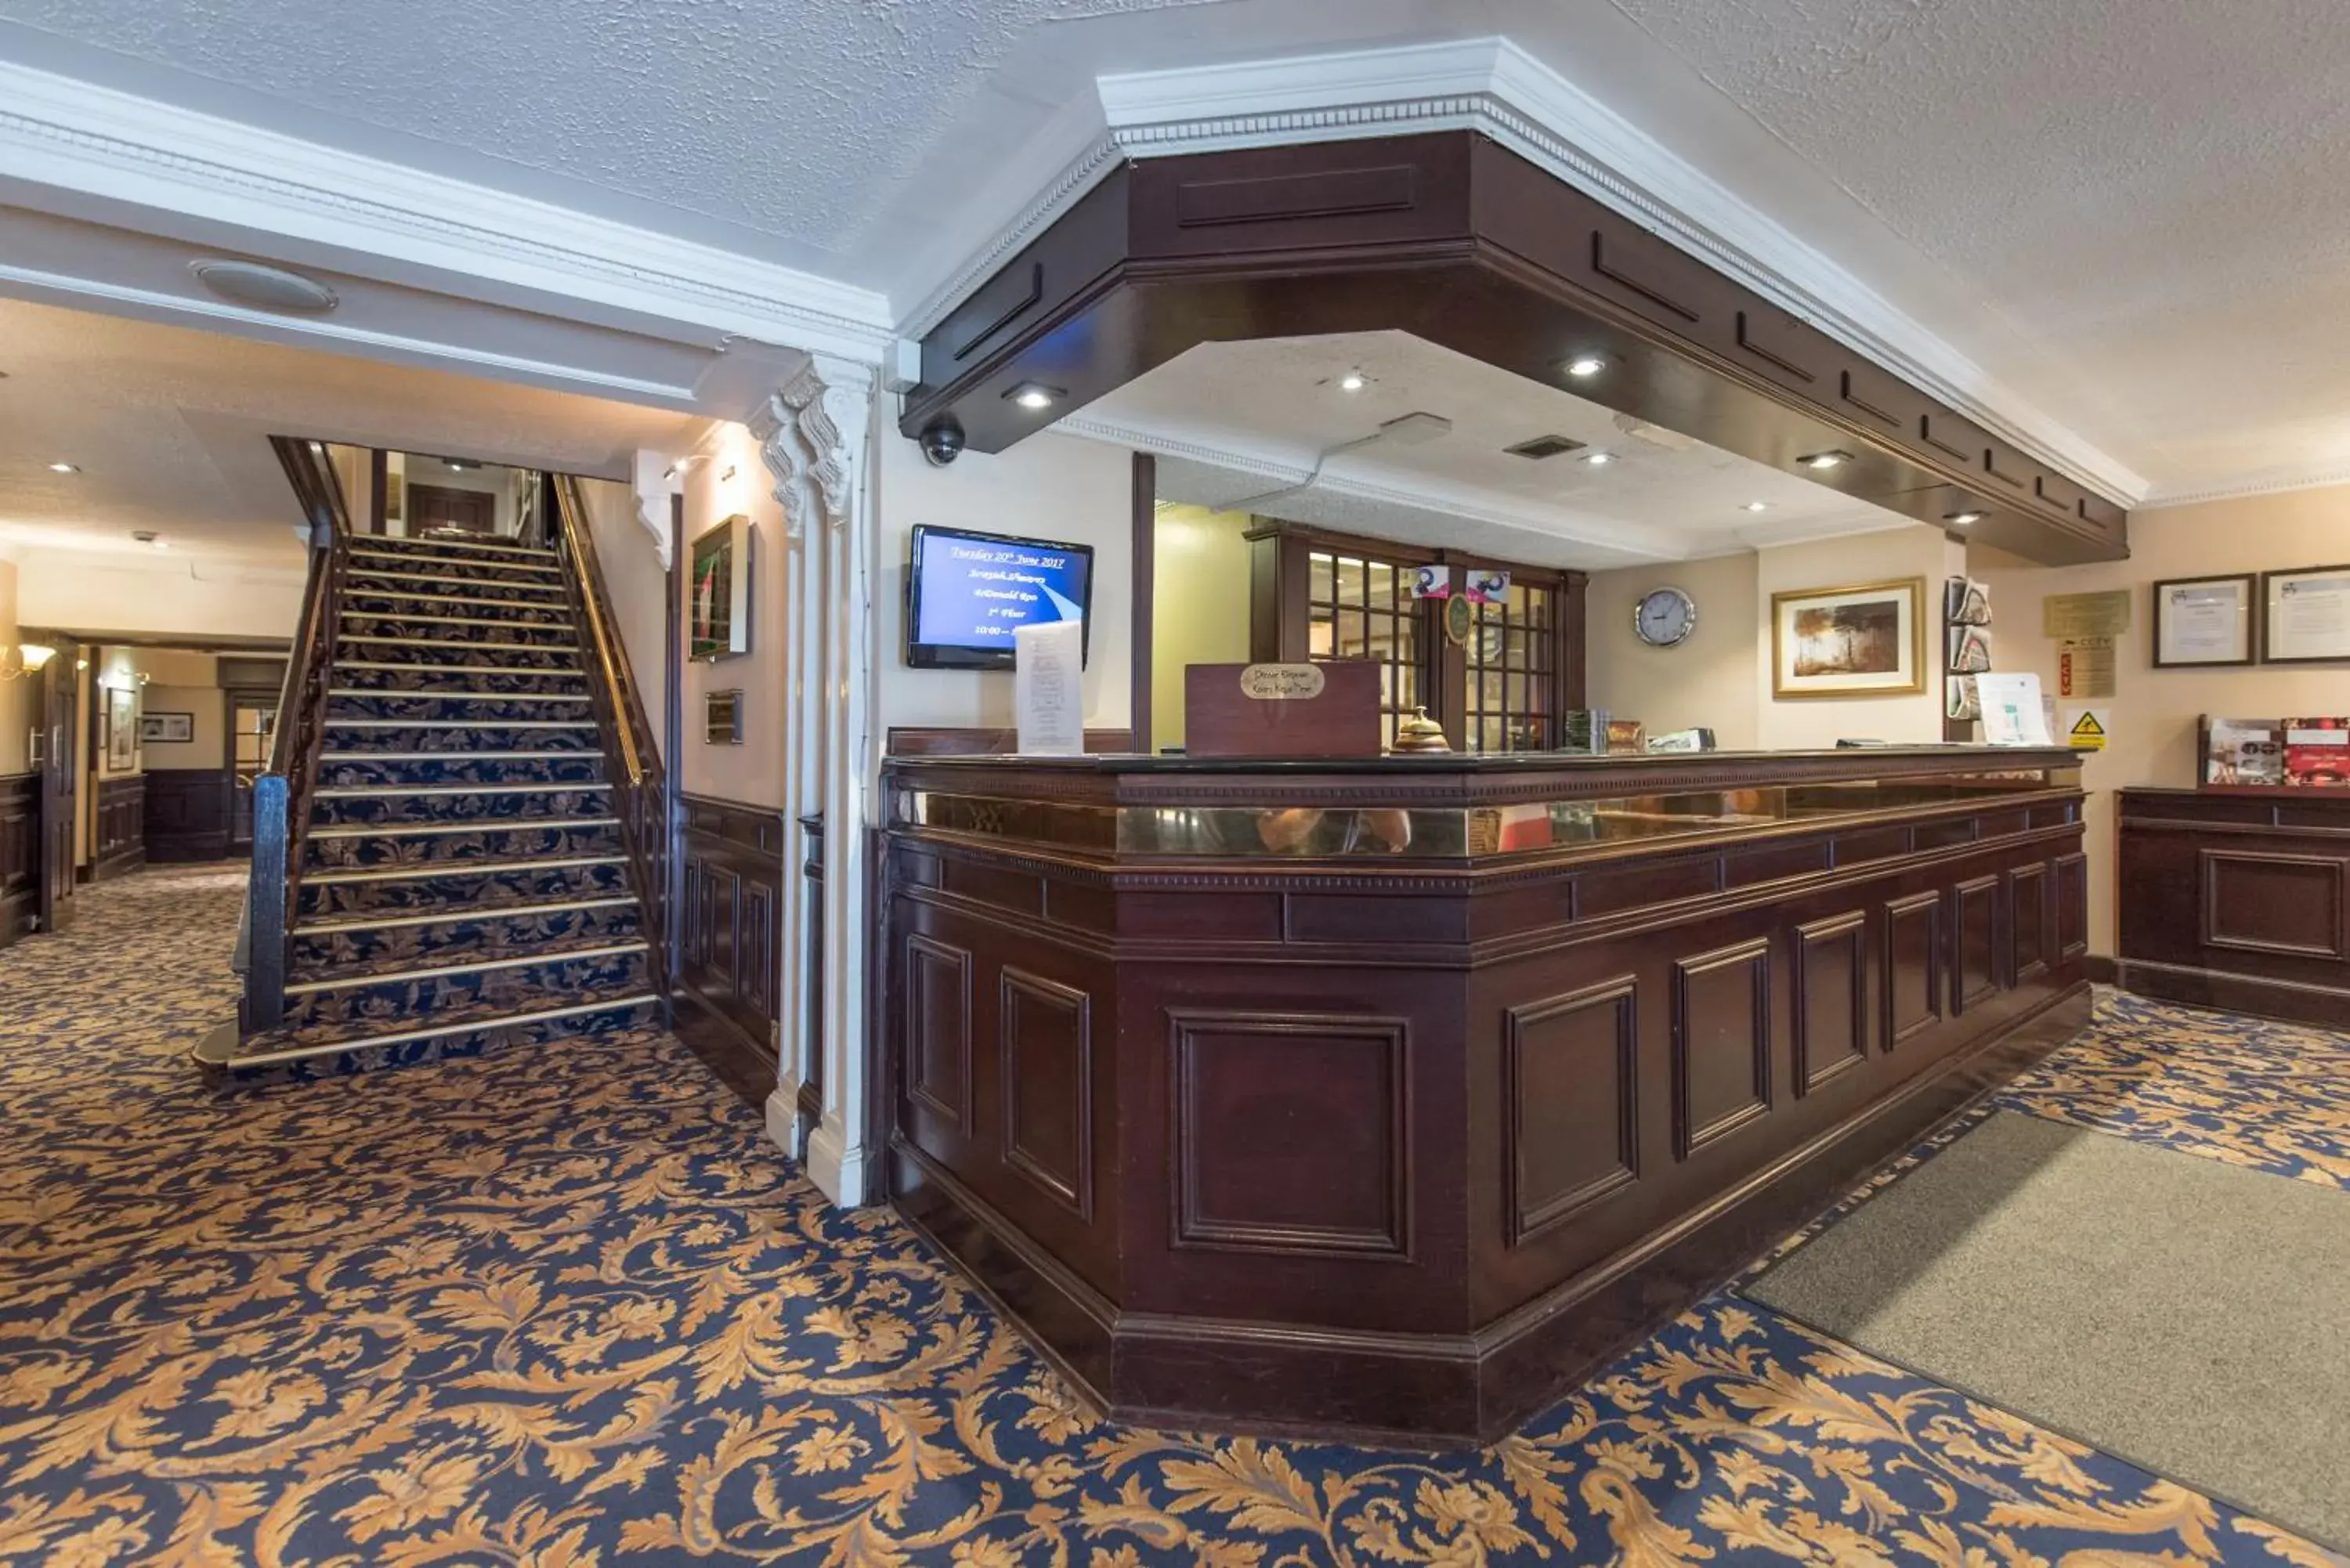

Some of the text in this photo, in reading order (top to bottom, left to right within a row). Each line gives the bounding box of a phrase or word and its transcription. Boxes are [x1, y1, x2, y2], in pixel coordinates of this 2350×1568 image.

[951, 547, 994, 562] Tuesday
[1016, 554, 1039, 564] June
[1040, 557, 1065, 567] 2017
